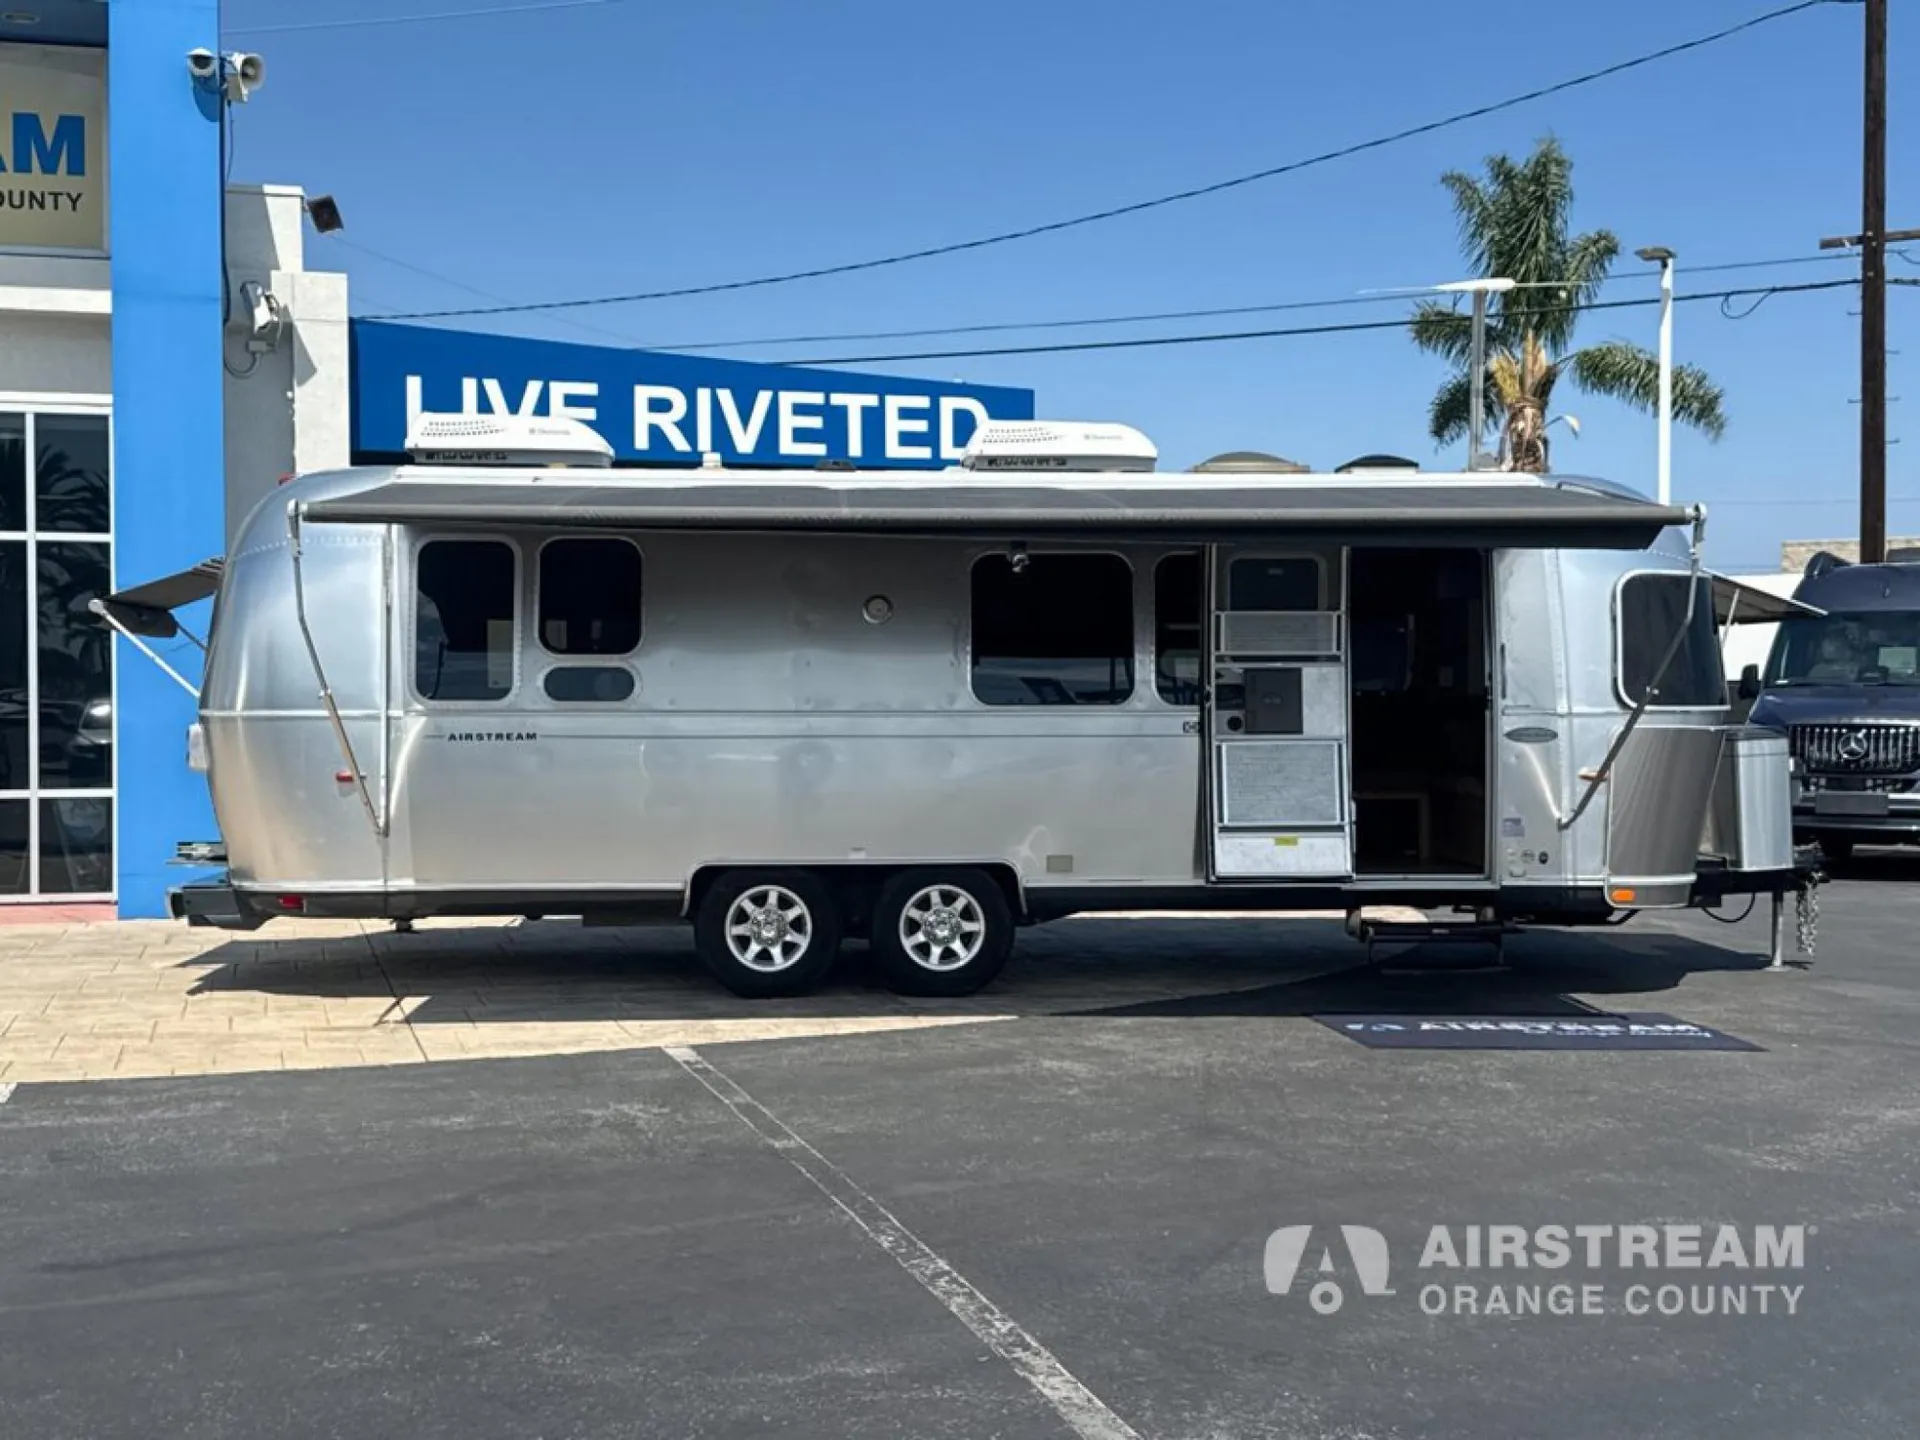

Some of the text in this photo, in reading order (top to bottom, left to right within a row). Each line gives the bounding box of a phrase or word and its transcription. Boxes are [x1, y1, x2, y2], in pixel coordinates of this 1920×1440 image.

[0, 112, 85, 176] M
[0, 188, 83, 211] UNTY
[633, 384, 990, 460] RIVETED
[447, 732, 537, 741] AIRSTREAM
